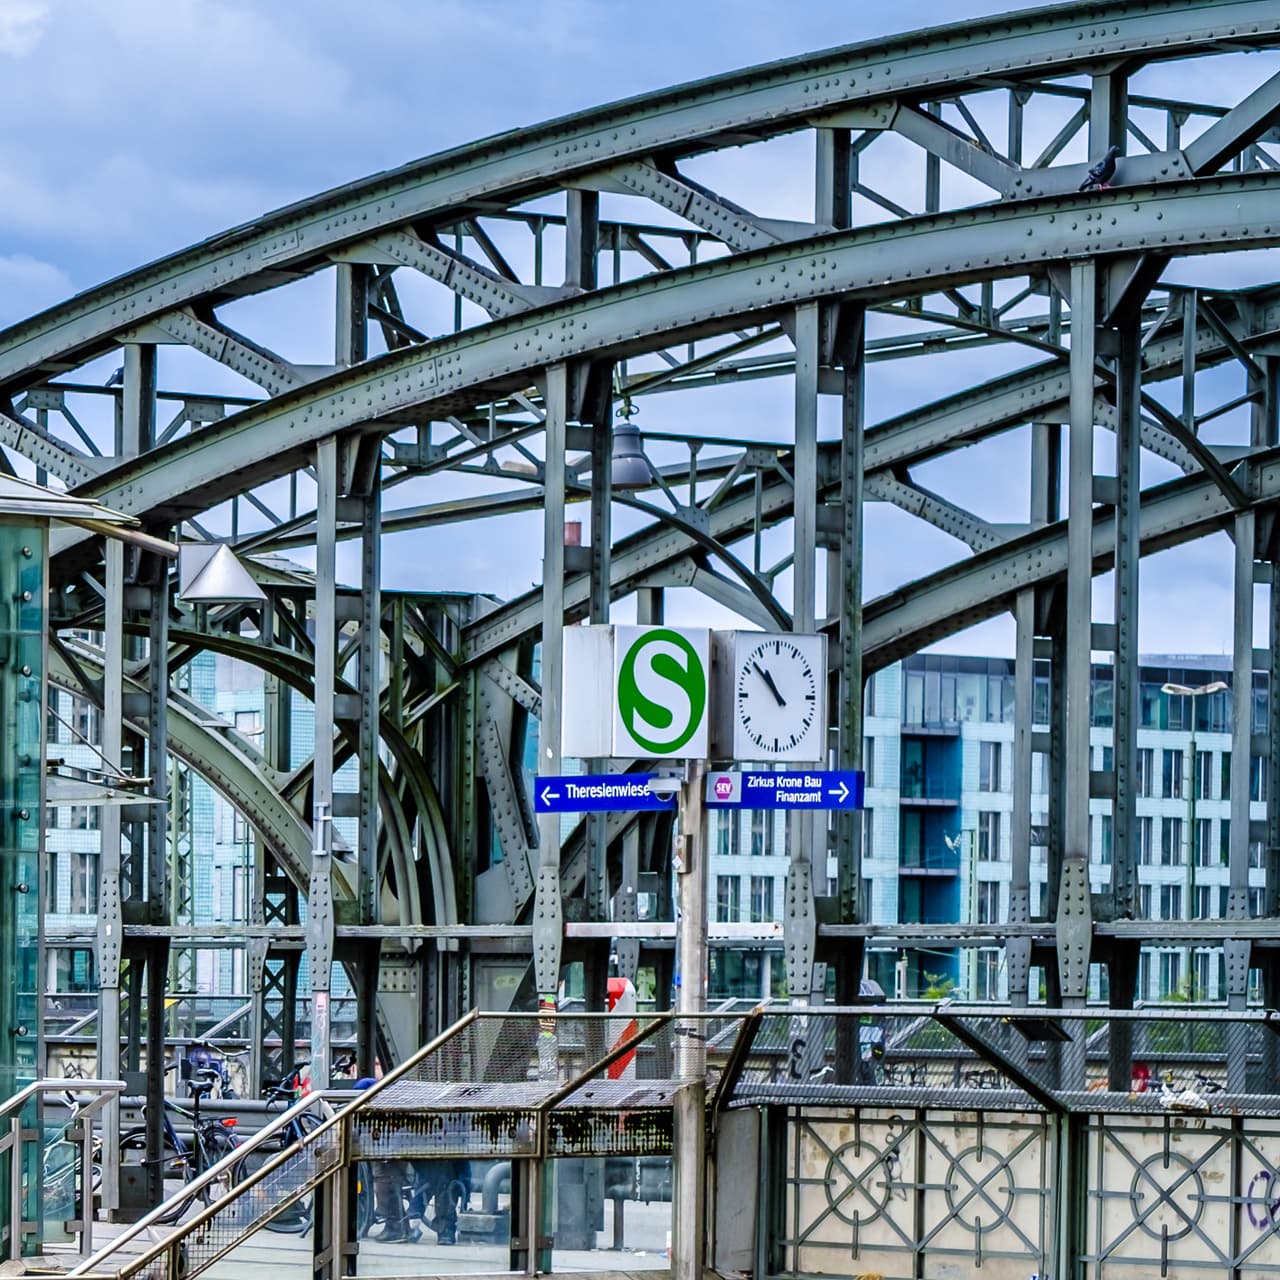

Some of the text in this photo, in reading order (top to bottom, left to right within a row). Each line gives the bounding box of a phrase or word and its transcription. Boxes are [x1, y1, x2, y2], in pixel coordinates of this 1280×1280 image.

[632, 640, 691, 744] S
[716, 783, 733, 794] SEV
[747, 775, 822, 789] Zirkus Krone Bau
[565, 782, 650, 799] Theresienwiese
[775, 790, 822, 804] Finanzamt
